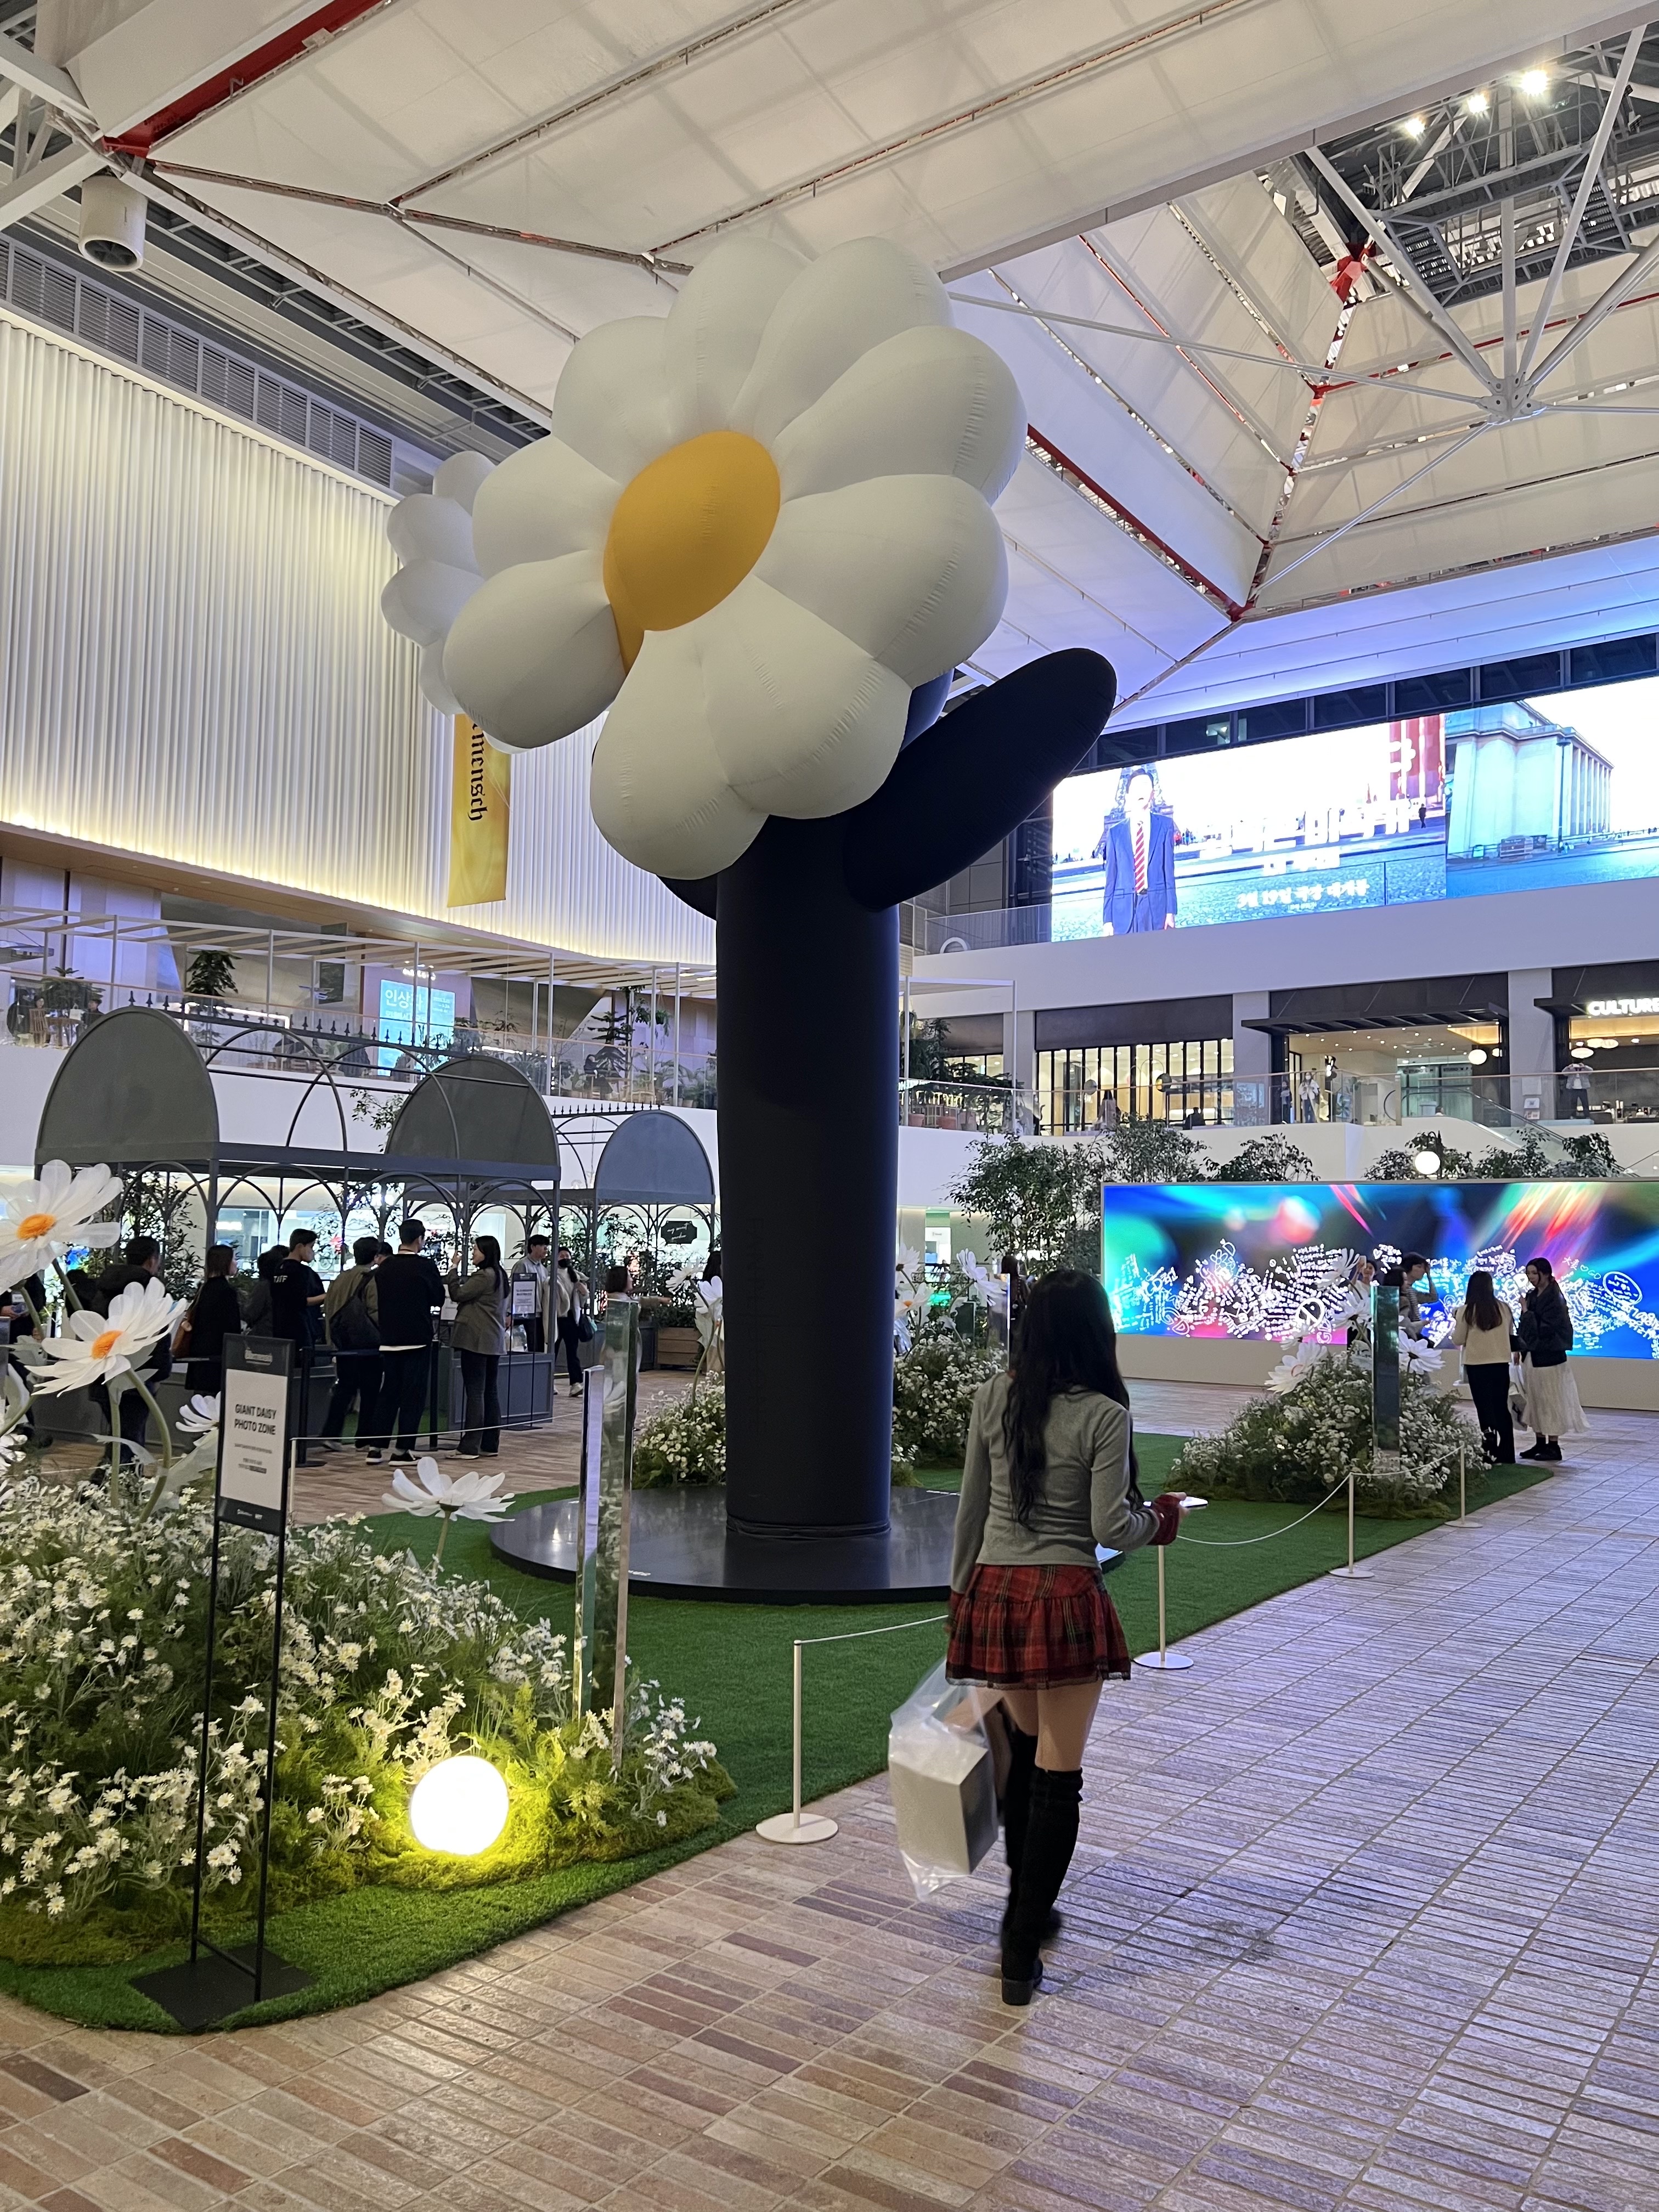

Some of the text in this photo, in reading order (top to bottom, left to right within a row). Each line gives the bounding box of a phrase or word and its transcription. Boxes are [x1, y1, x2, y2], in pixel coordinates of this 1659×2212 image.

[235, 1403, 276, 1420] GIANT DAISY
[234, 1418, 276, 1435] PHOTO ZONE
